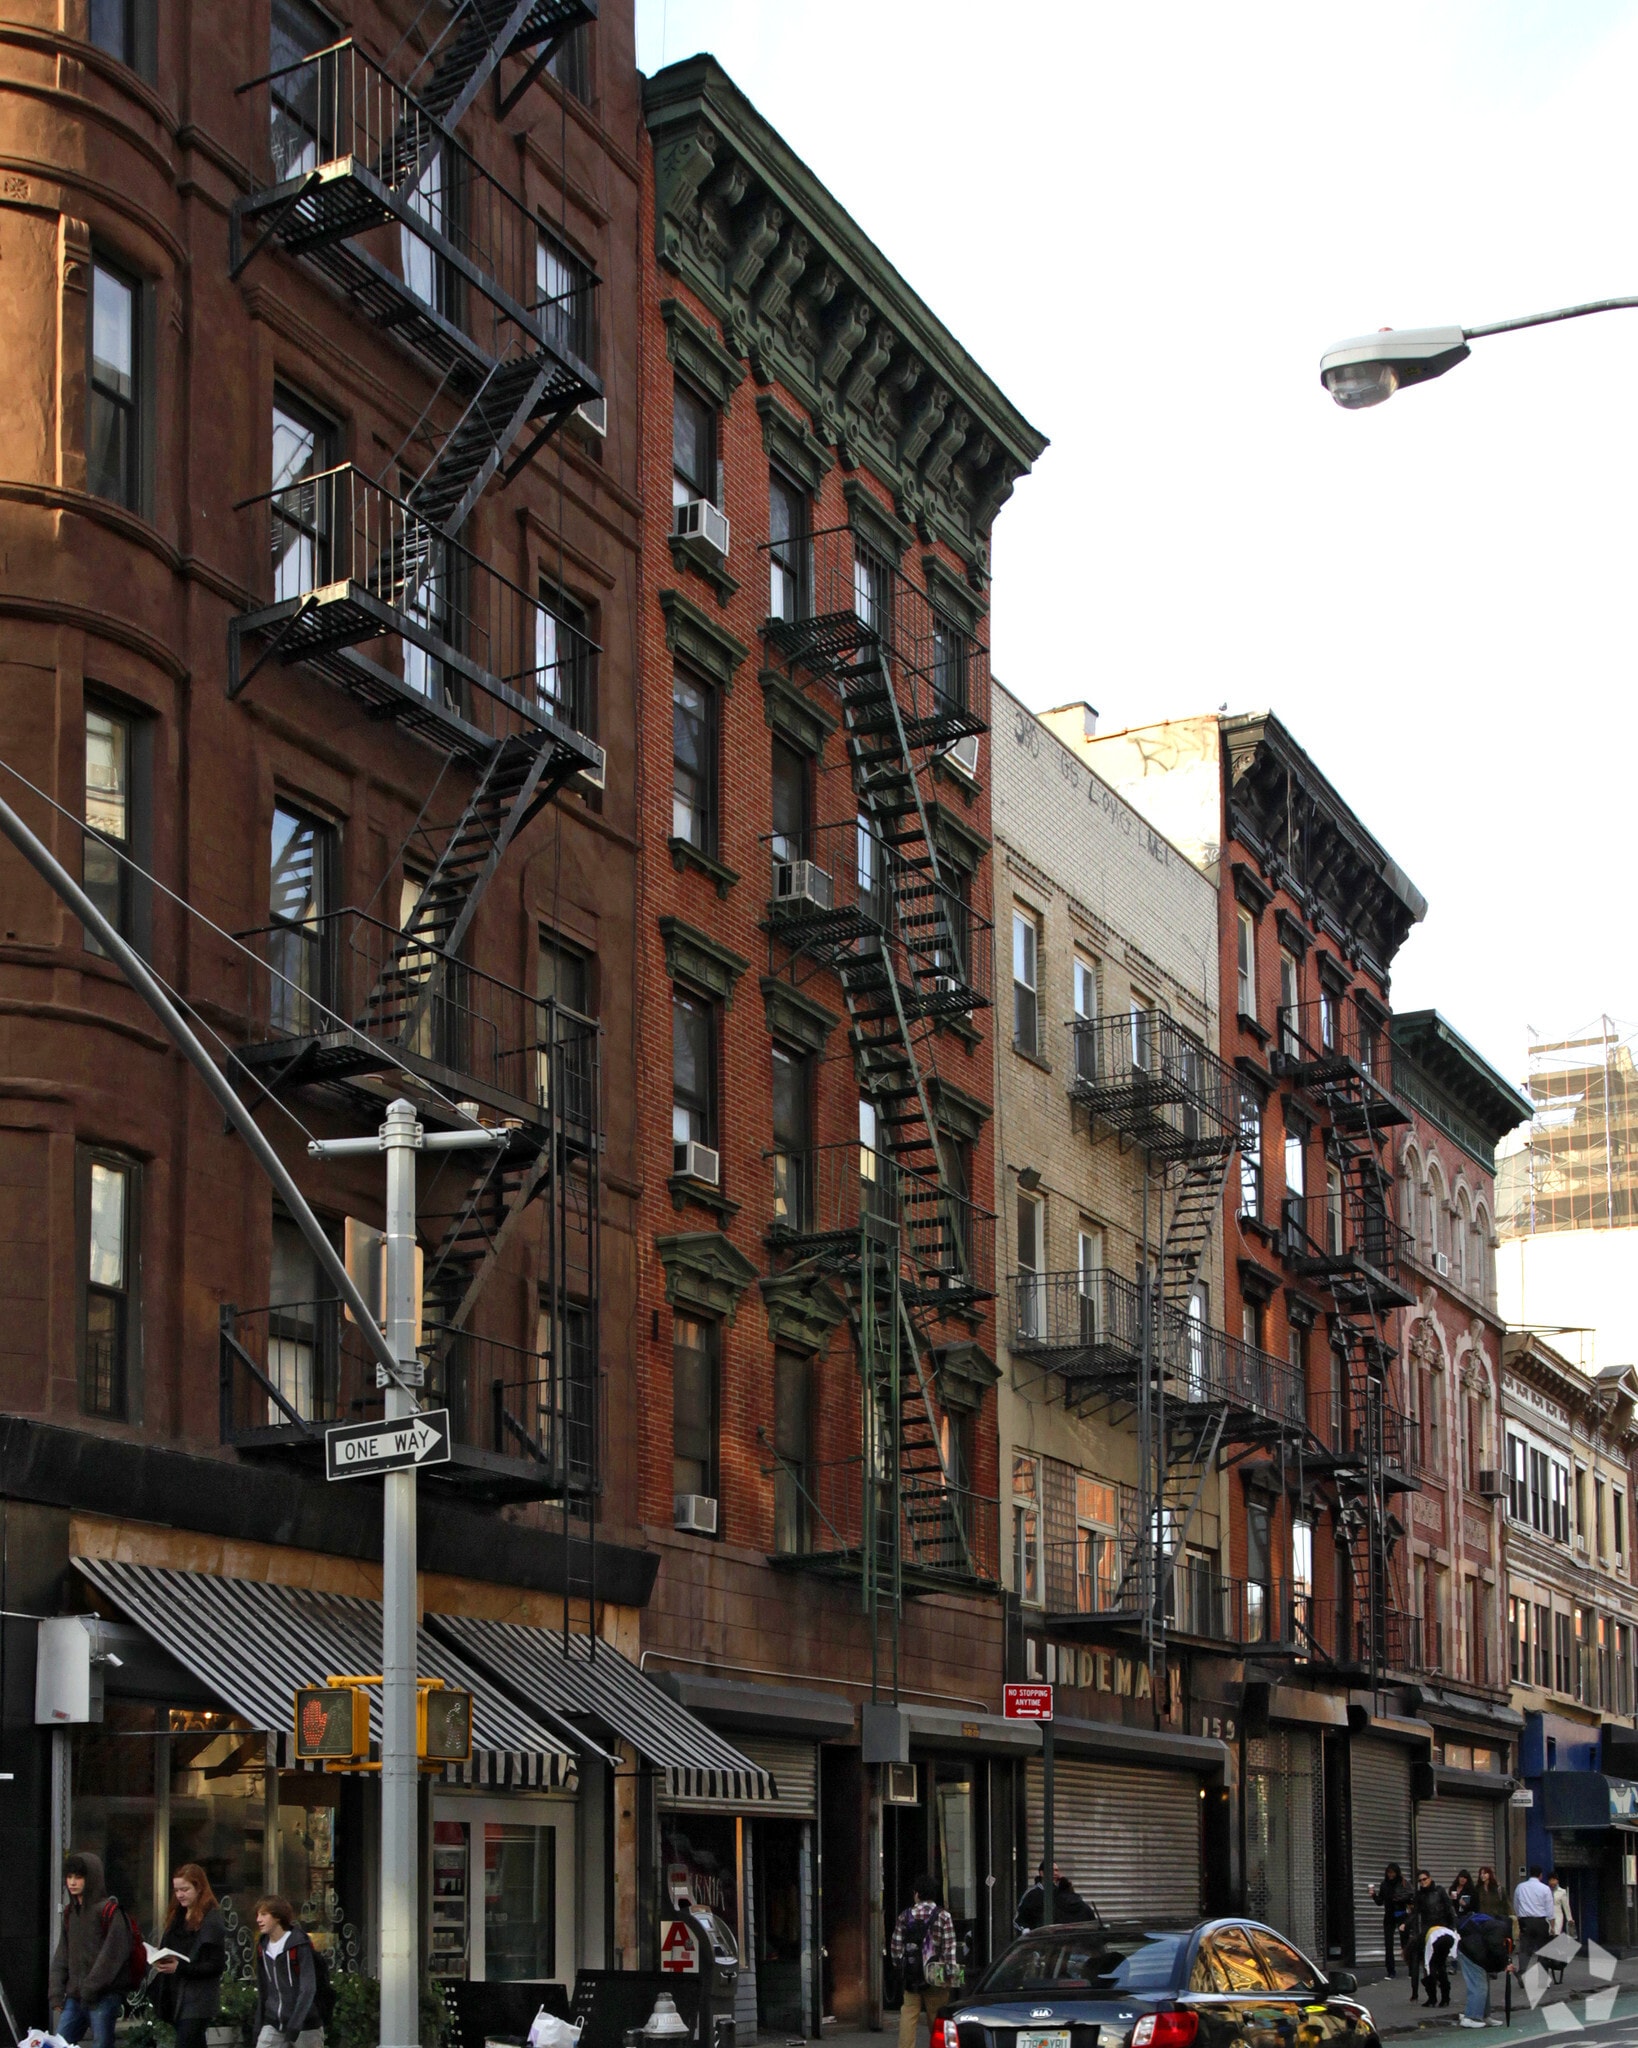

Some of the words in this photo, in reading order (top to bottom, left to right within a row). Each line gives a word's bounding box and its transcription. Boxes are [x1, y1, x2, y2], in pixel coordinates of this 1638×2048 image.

[345, 1438, 379, 1461] ONE
[394, 1429, 429, 1453] WAY
[1019, 1689, 1048, 1698] STOPPING
[1015, 1698, 1041, 1707] ANYTIME
[1202, 1715, 1235, 1741] 159
